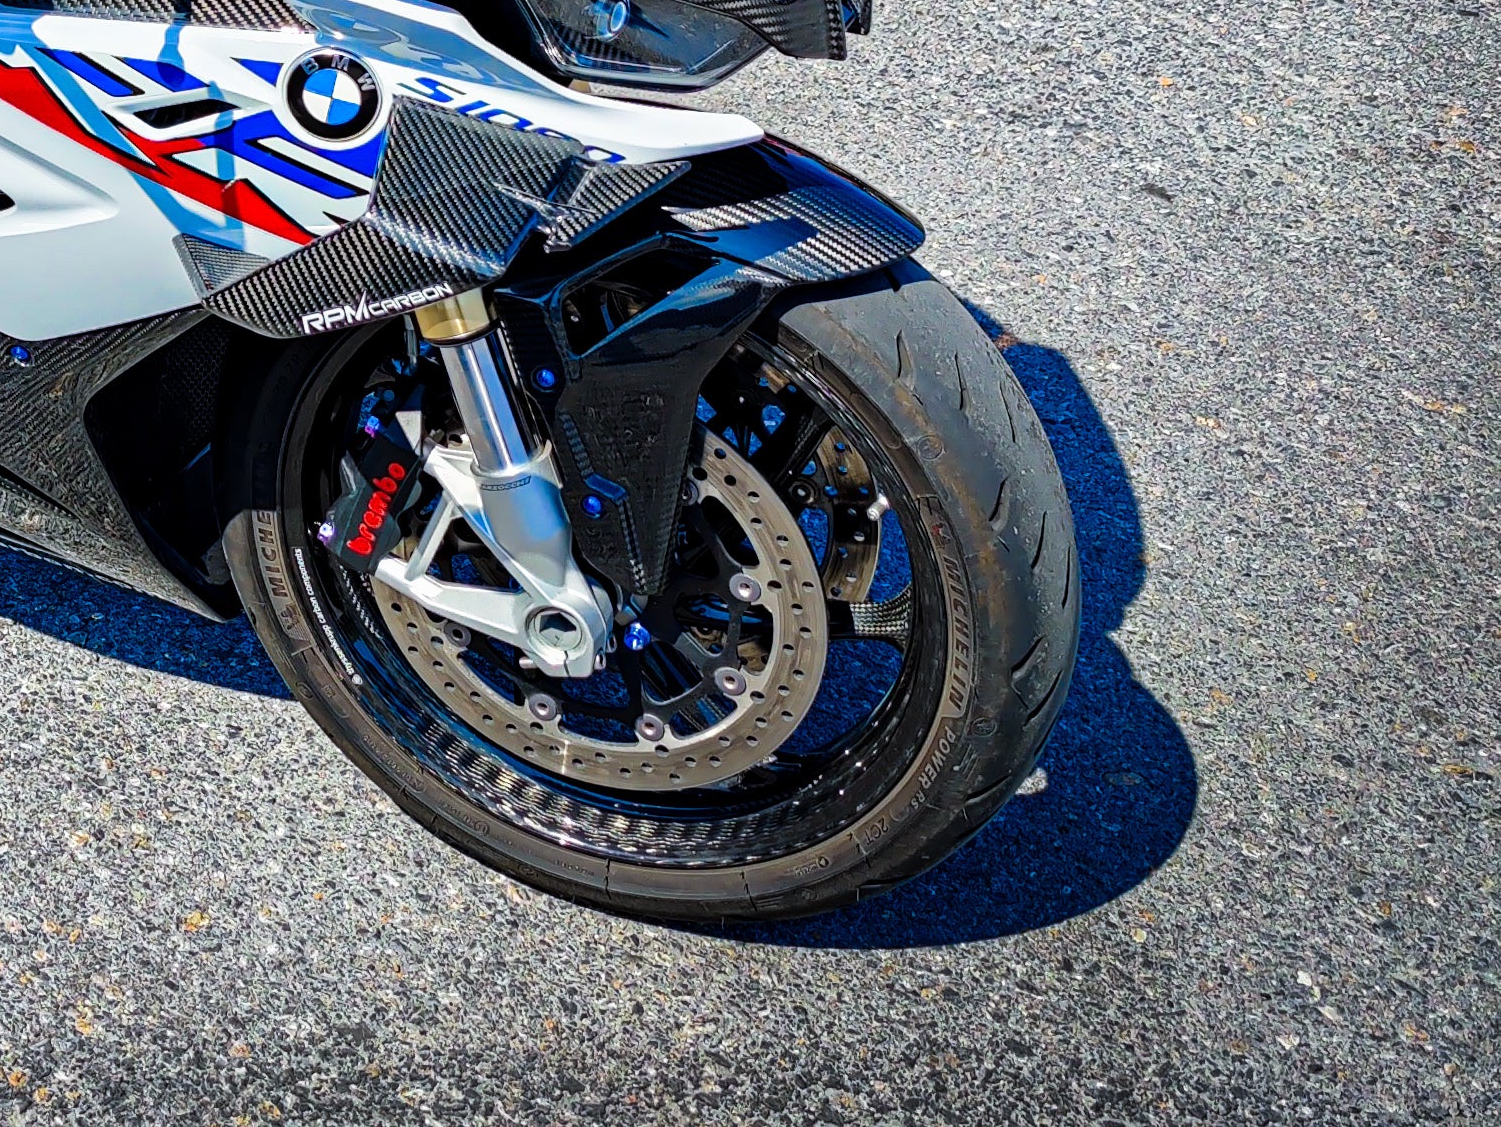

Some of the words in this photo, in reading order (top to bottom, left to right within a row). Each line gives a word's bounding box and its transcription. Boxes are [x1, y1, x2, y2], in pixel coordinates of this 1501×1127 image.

[347, 463, 406, 556] brembo
[943, 555, 971, 711] MICHELIN
[918, 725, 956, 790] POWER
